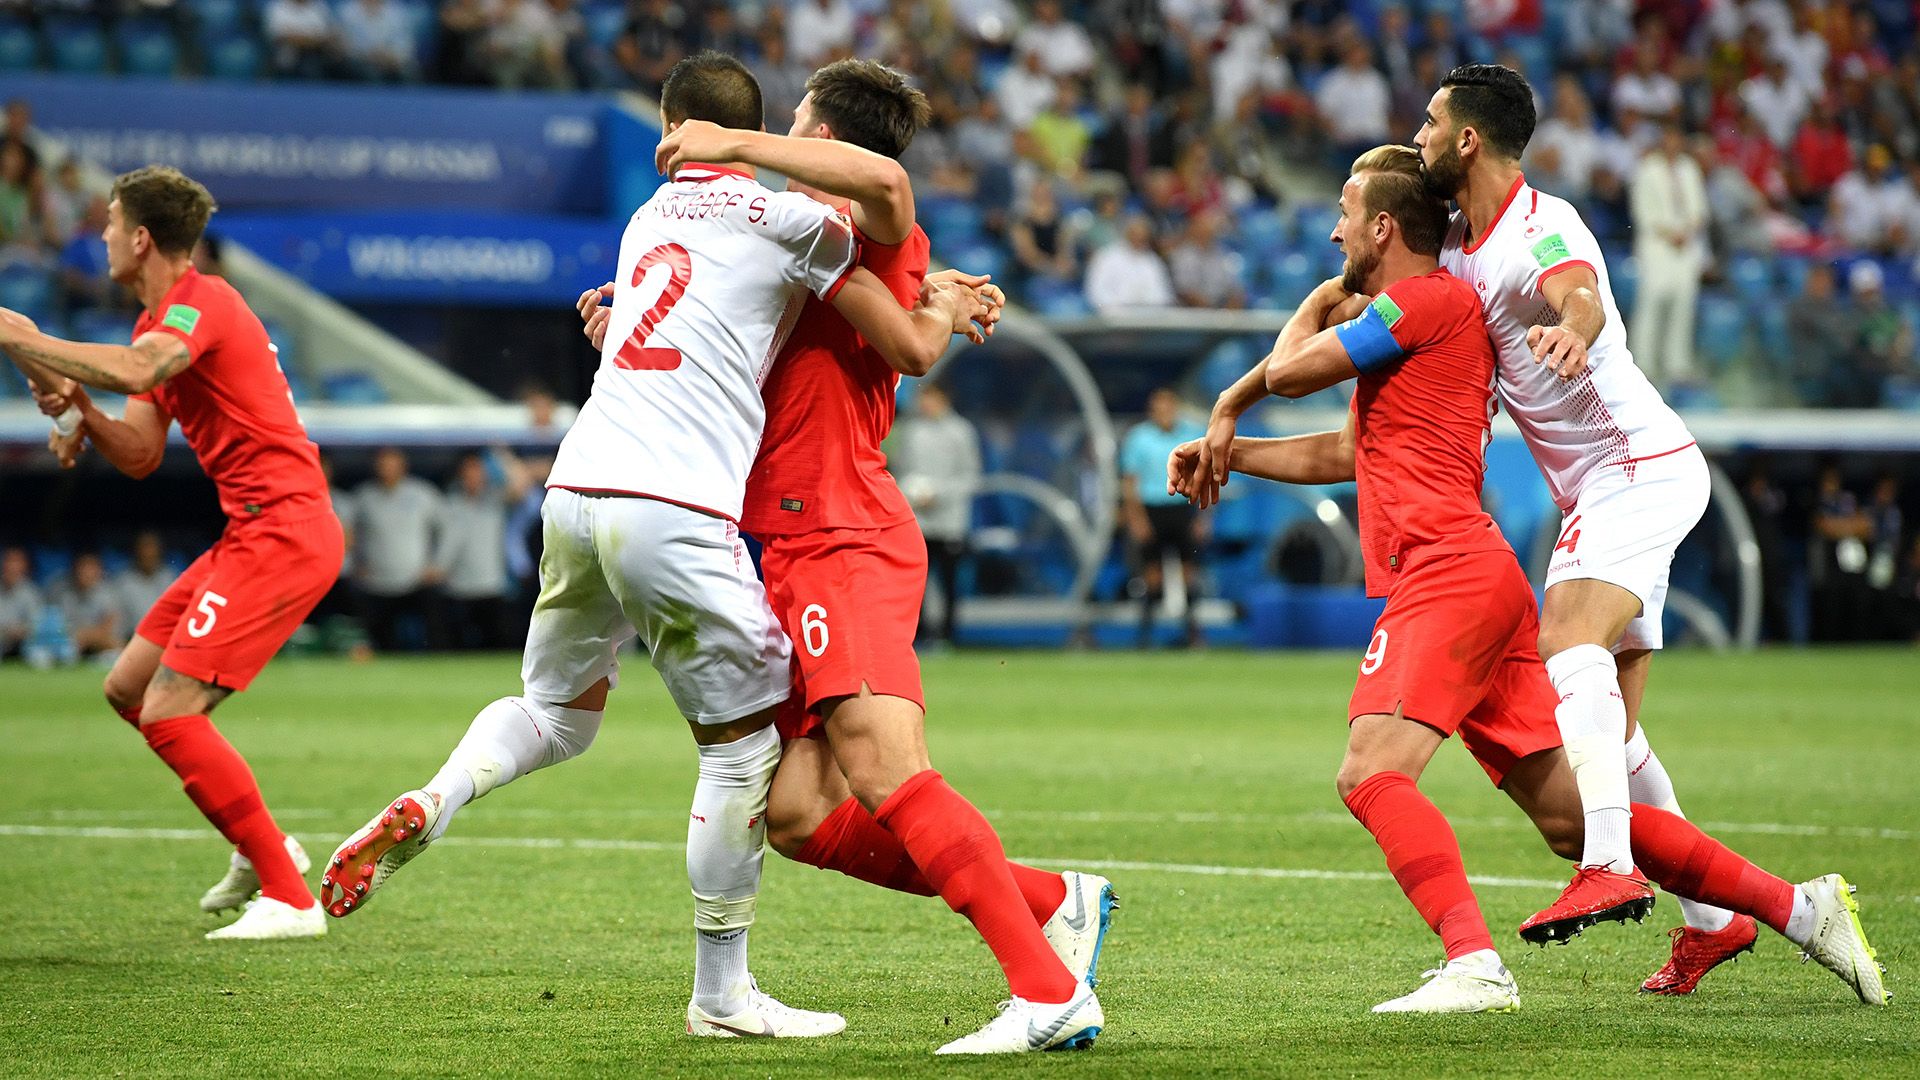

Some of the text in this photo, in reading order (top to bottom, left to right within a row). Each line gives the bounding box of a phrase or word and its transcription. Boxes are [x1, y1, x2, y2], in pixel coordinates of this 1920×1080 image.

[747, 196, 768, 226] S.
[613, 242, 692, 370] 2
[1554, 515, 1582, 553] 4
[187, 590, 228, 638] 5
[801, 603, 829, 657] 6
[1360, 629, 1389, 675] 9
